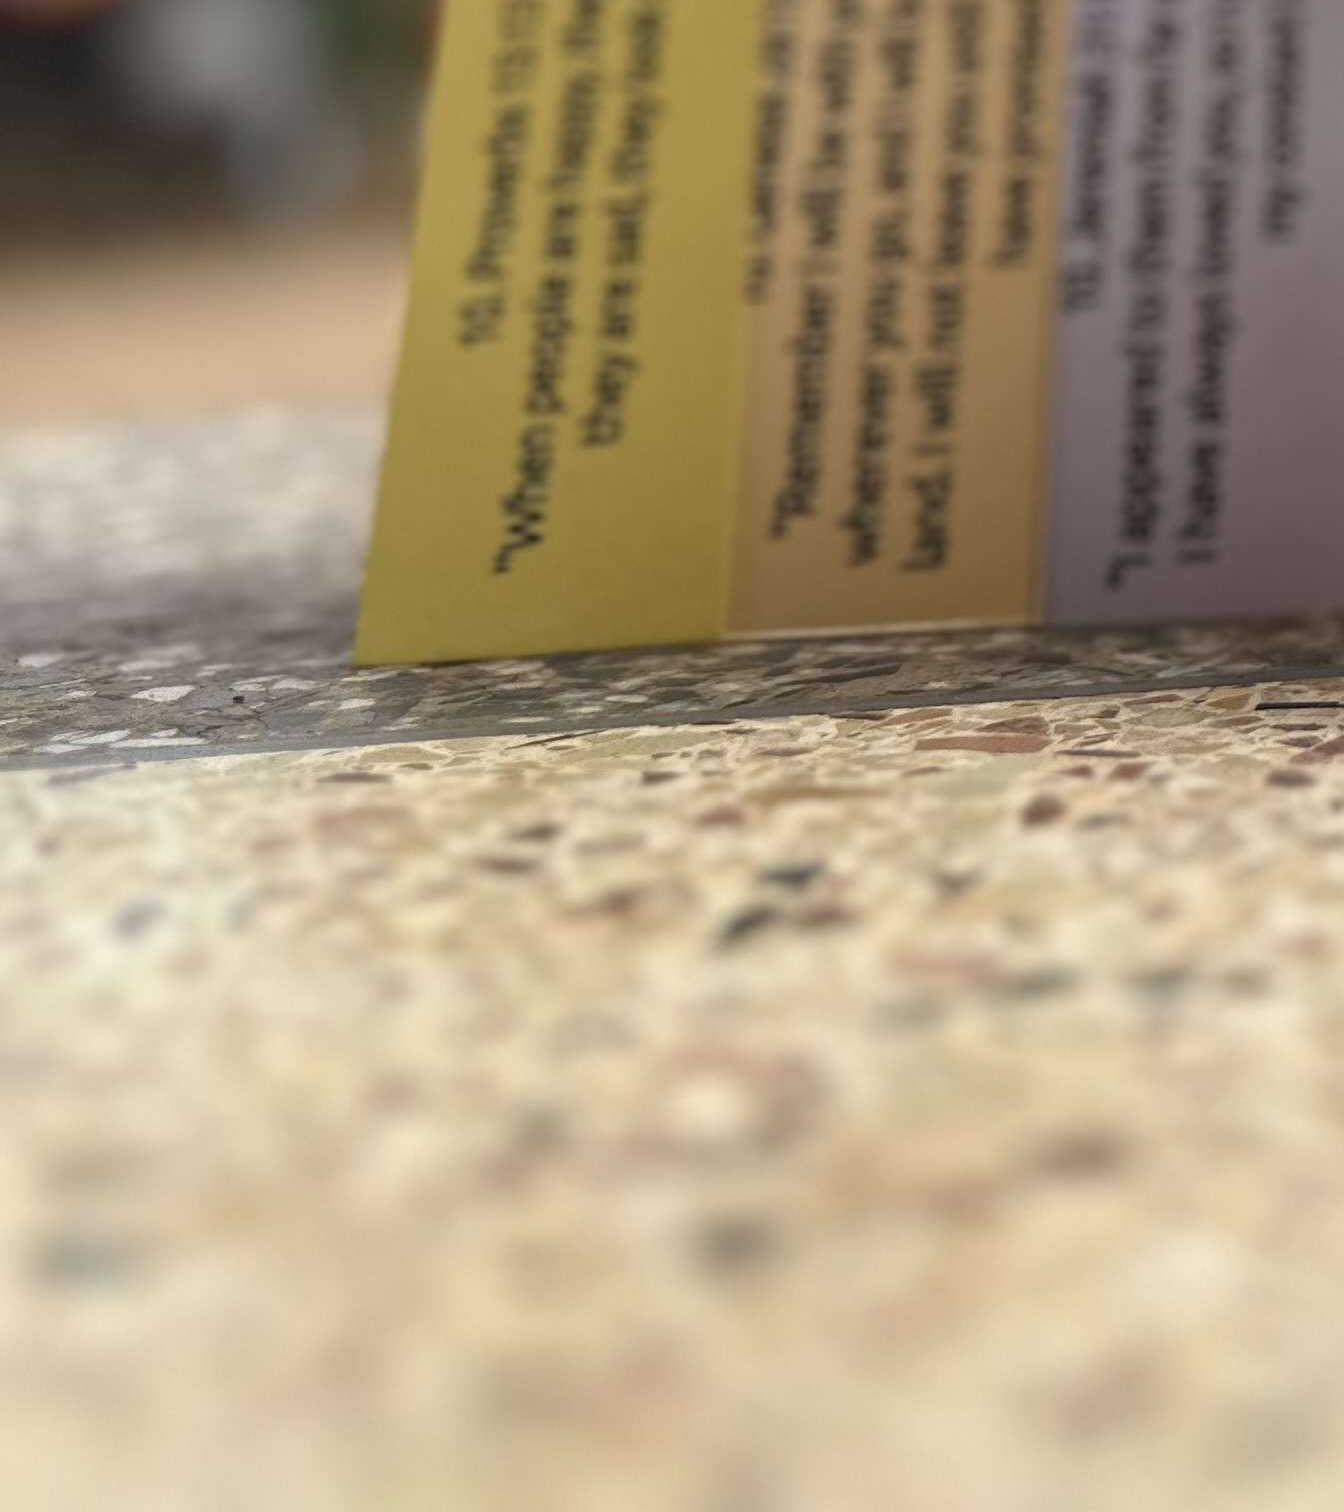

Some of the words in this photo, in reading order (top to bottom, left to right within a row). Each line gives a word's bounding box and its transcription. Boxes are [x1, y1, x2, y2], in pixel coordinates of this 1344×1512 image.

[542, 202, 578, 260] are
[513, 275, 579, 416] people
[600, 280, 641, 341] are
[578, 351, 642, 446] they
